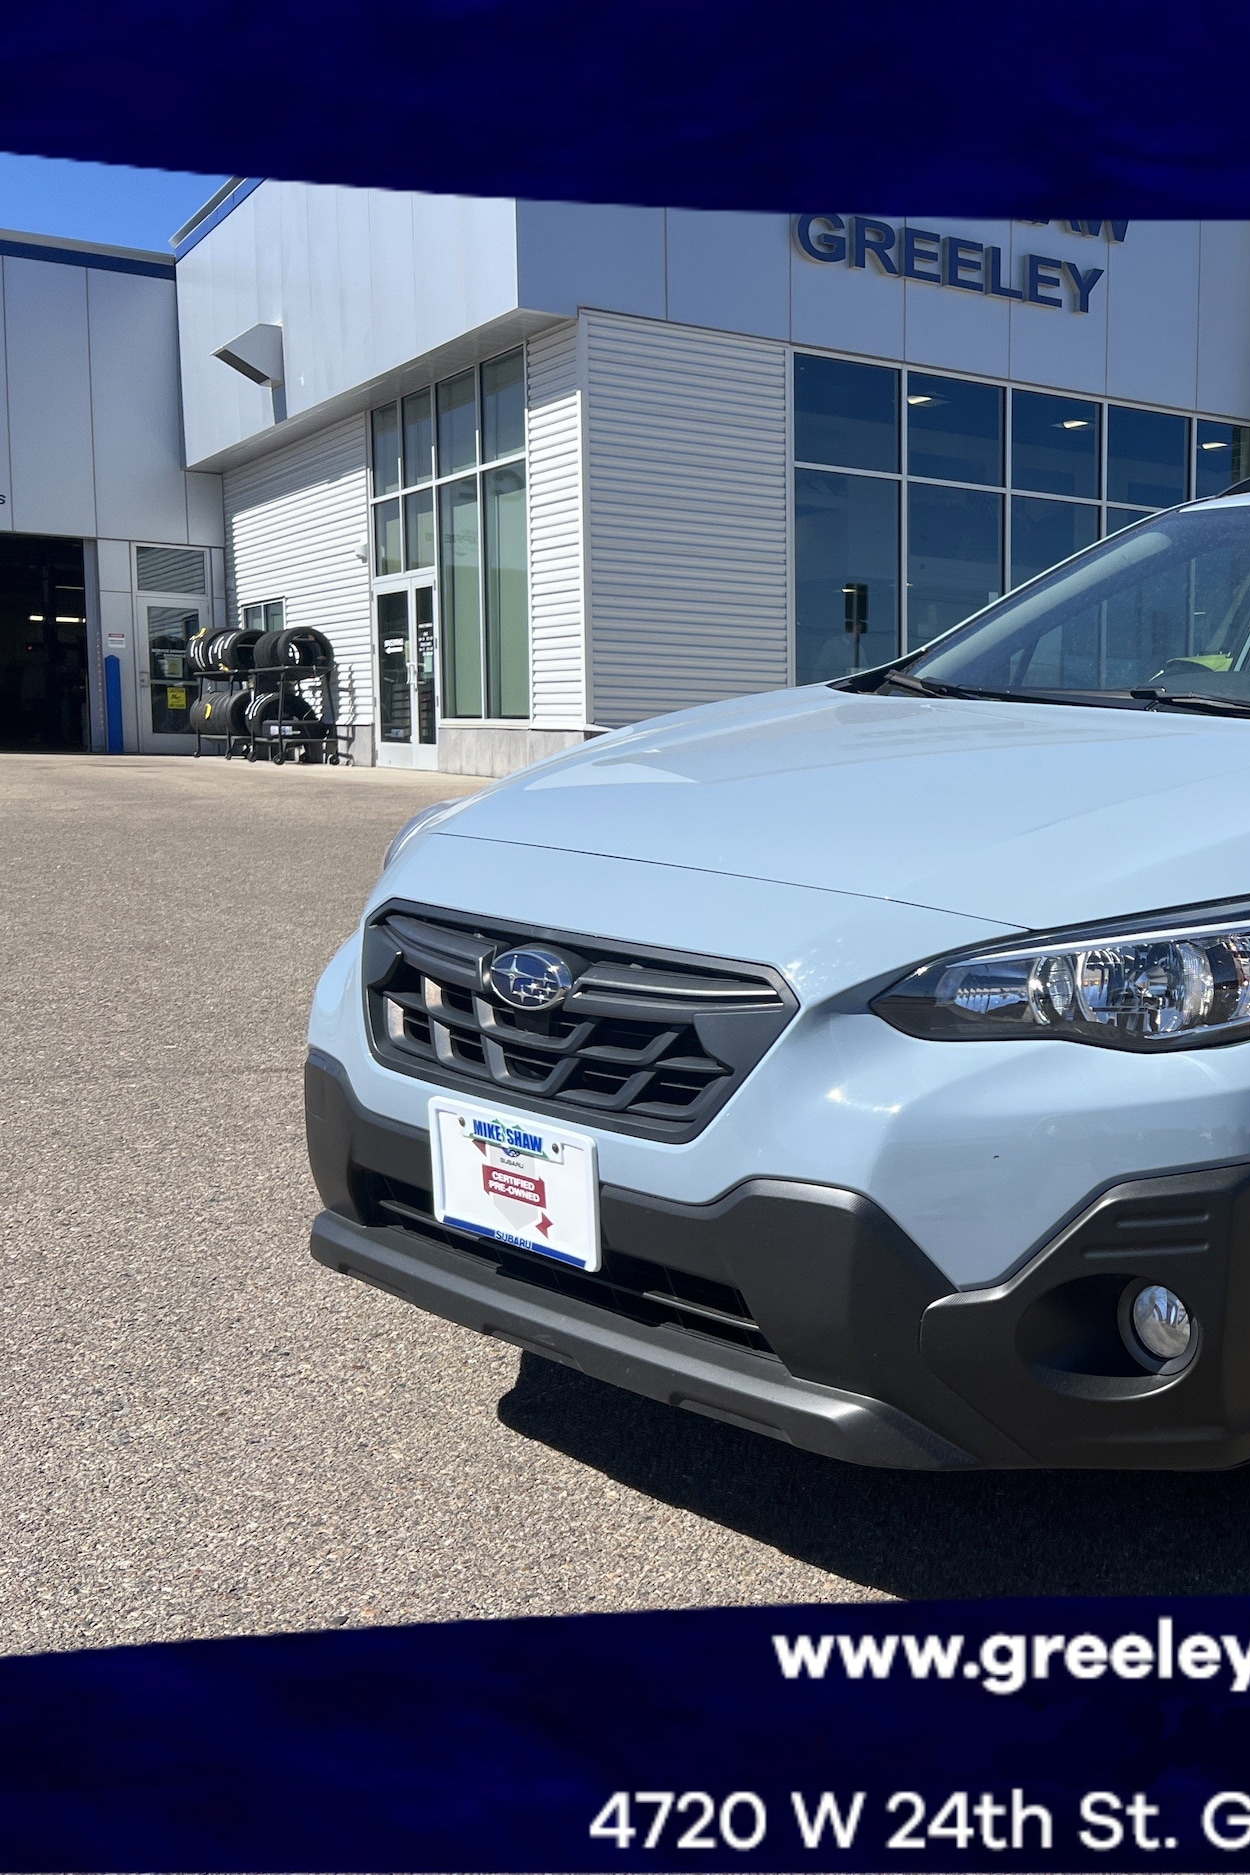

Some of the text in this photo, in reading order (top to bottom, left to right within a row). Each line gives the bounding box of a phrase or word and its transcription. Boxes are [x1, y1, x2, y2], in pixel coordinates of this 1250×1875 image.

[795, 213, 1105, 315] GREELEY
[473, 1119, 543, 1153] MIKE SHAW
[500, 1157, 524, 1168] SUBARU
[488, 1180, 540, 1203] PRE-OWNED
[491, 1171, 535, 1191] CERTIFIED
[495, 1231, 532, 1249] SUBARU
